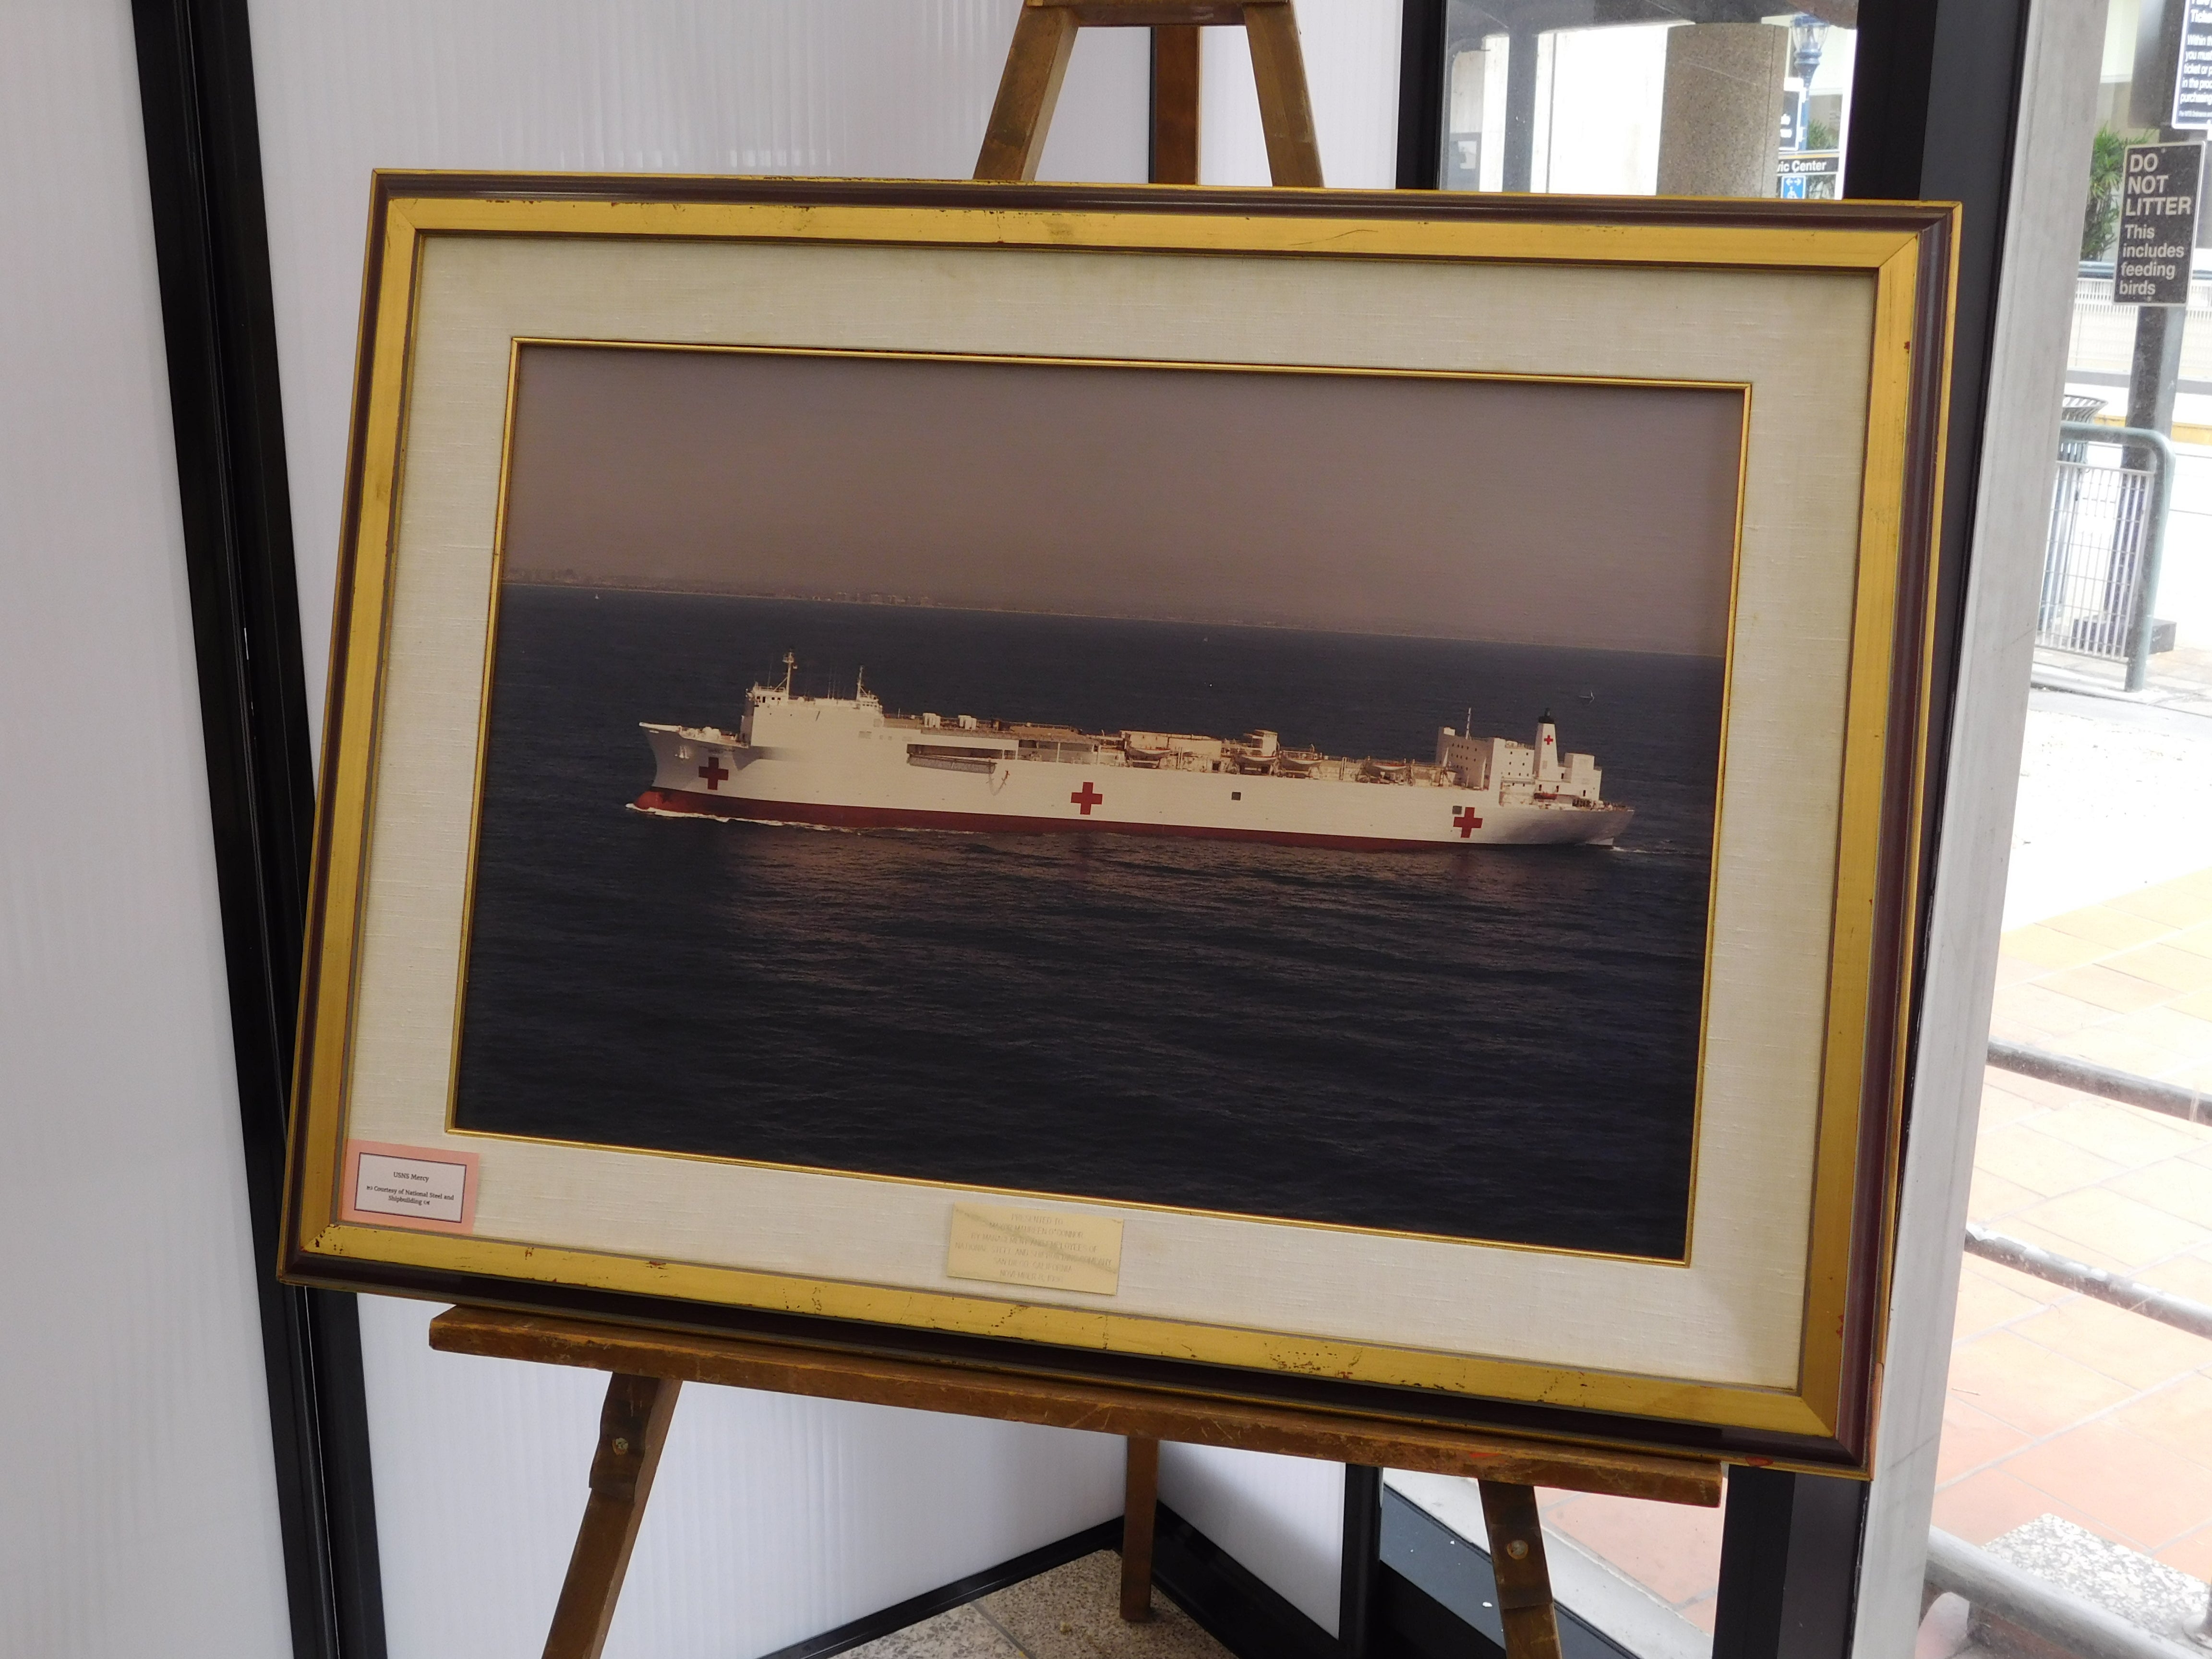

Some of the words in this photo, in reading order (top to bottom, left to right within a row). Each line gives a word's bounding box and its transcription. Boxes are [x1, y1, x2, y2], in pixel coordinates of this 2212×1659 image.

[2187, 34, 2206, 46] Within
[2185, 51, 2197, 62] you
[2184, 63, 2200, 74] ticket
[2201, 66, 2208, 74] or
[2182, 77, 2188, 88] in
[2189, 77, 2199, 88] the
[2180, 91, 2212, 105] purchasing
[1791, 160, 1827, 172] Center
[2129, 153, 2159, 172] DO
[2128, 175, 2169, 194] NOT
[2125, 196, 2192, 216] LITTER
[2125, 224, 2155, 239] This
[2122, 243, 2185, 258] includes
[2121, 262, 2176, 280] feeding
[2119, 280, 2156, 295] birds
[410, 1174, 429, 1183] Mercy
[374, 1185, 397, 1194] Courtesy
[405, 1190, 428, 1198] National
[388, 1195, 422, 1206] Shipbuilding
[1011, 1213, 1052, 1225] PRESENTED
[1055, 1217, 1064, 1226] TO
[1015, 1248, 1029, 1256] AND
[1089, 1245, 1097, 1253] OF
[1032, 1261, 1072, 1272] CALIFORNIA
